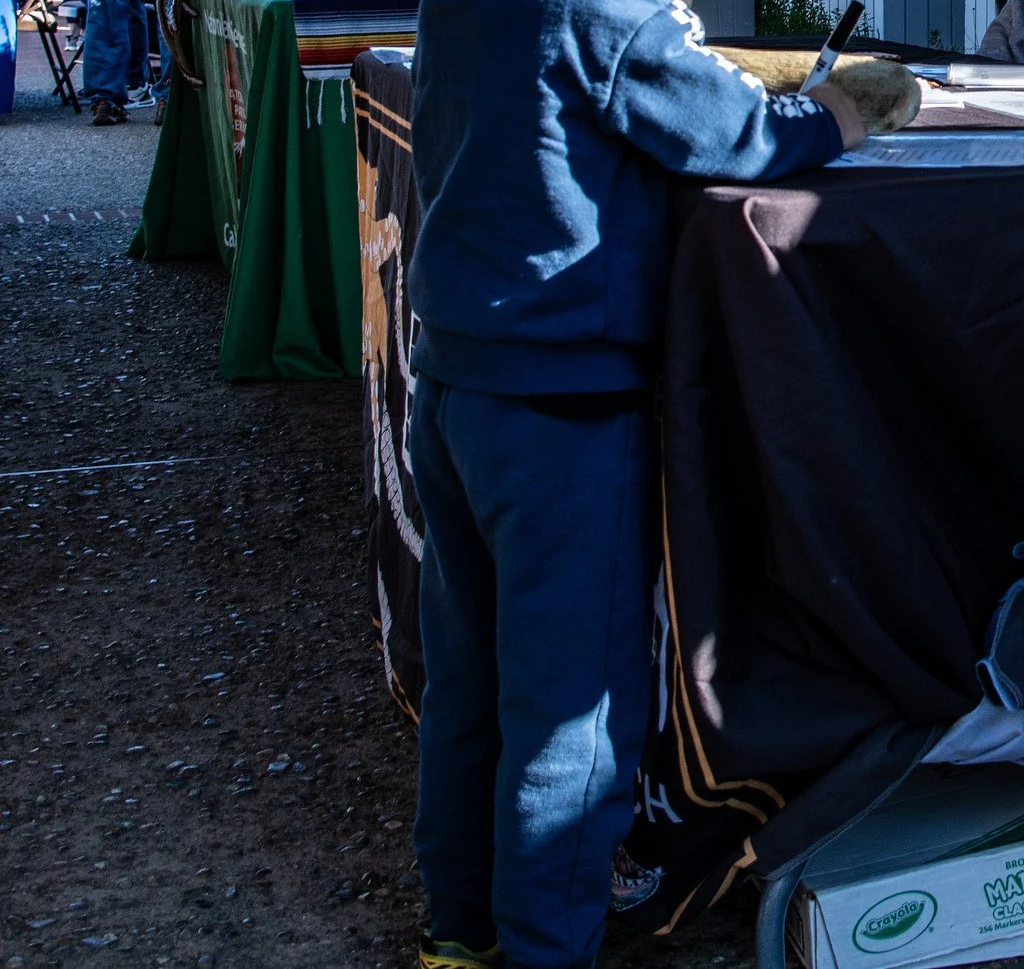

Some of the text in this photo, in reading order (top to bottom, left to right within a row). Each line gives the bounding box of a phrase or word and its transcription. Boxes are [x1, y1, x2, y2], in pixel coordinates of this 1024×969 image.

[866, 901, 920, 933] Crayola
[978, 923, 994, 934] 256
[994, 916, 1024, 931] Markers
